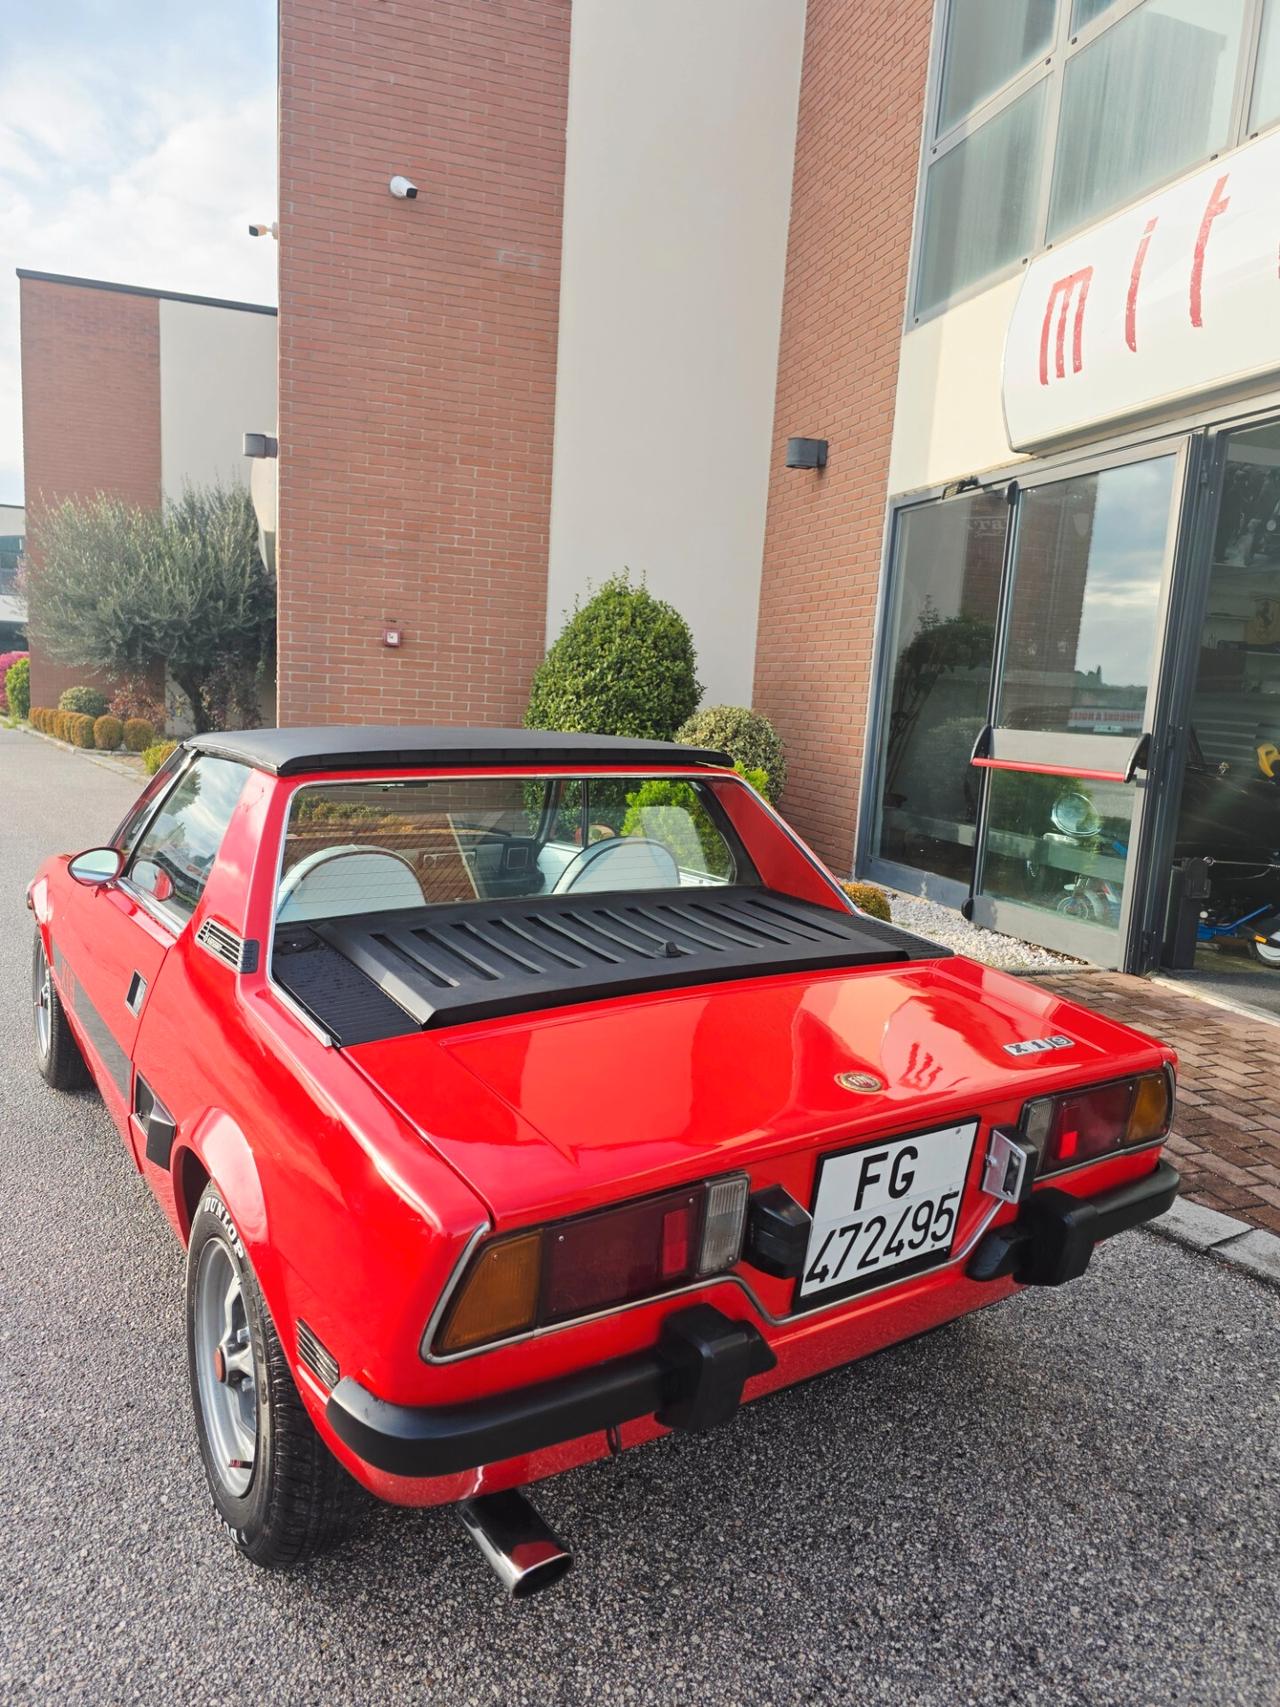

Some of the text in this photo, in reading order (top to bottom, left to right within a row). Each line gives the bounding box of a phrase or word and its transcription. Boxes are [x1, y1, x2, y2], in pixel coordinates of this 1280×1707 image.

[1039, 173, 1280, 386] mit
[853, 1145, 919, 1212] FG
[203, 1196, 245, 1259] DUNLOP
[804, 1190, 960, 1284] 472495
